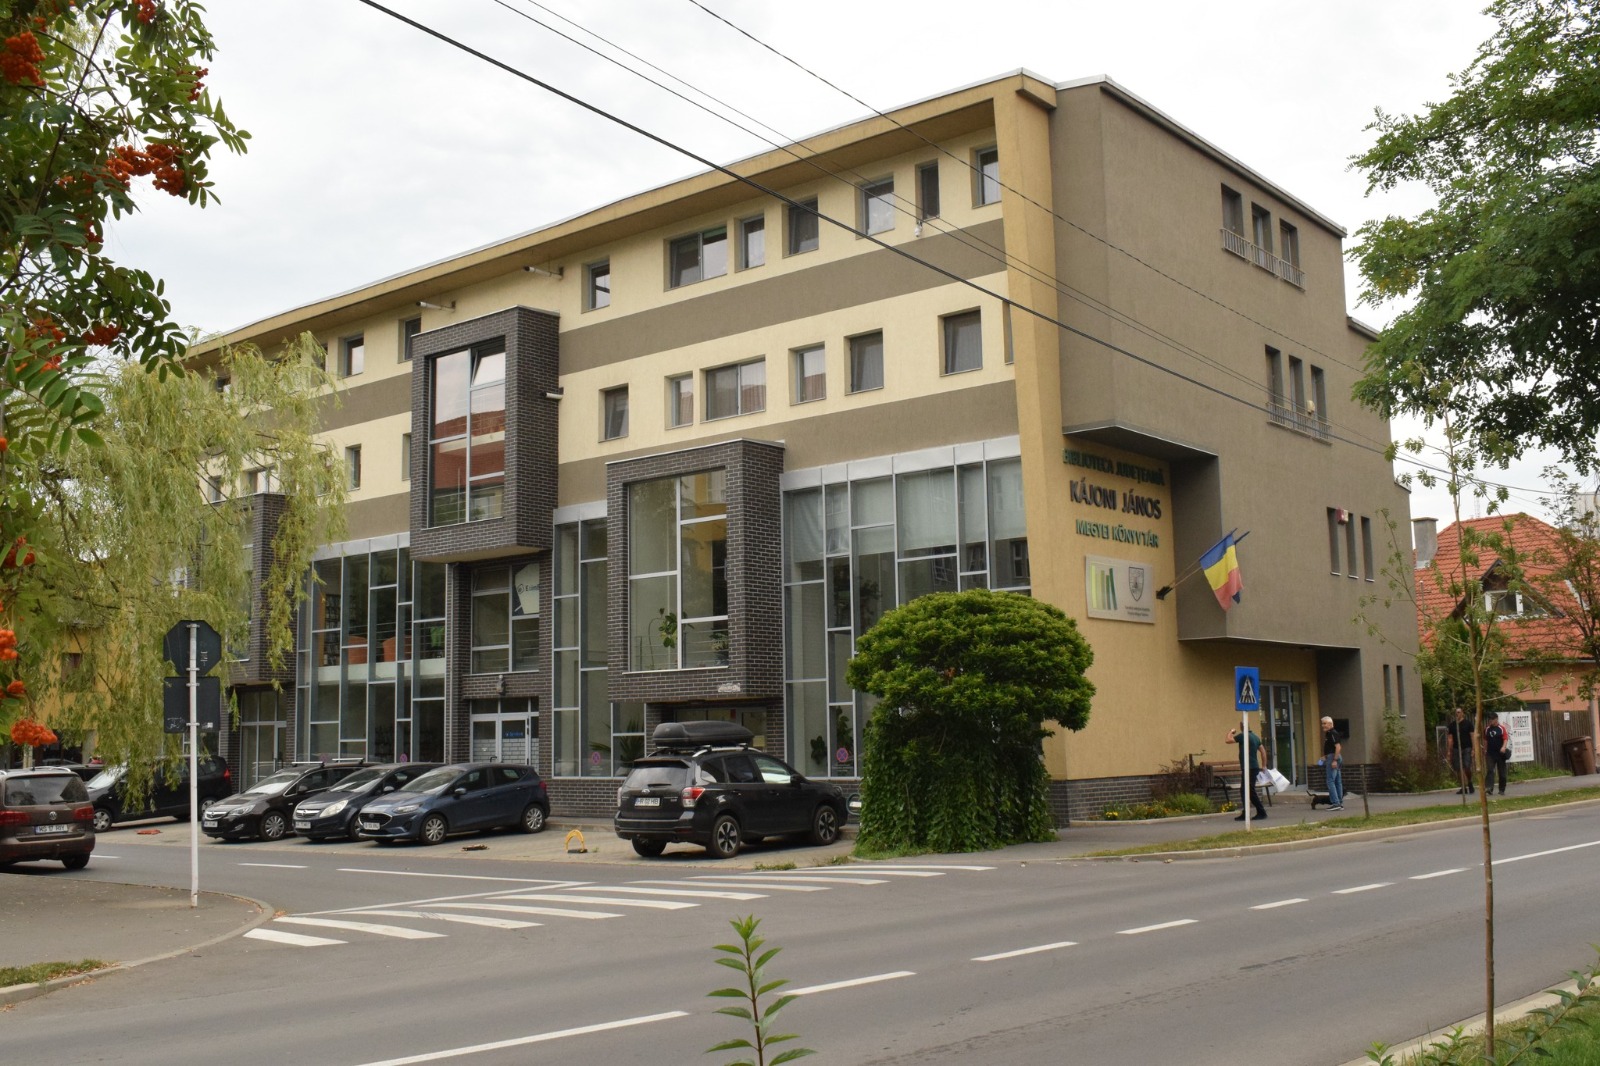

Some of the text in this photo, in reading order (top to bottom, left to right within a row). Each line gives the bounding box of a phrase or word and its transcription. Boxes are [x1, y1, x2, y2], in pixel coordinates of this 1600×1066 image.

[1063, 449, 1114, 474] BIBLIOTECA
[1070, 477, 1162, 520] KÁJONI JÁNOS
[1076, 519, 1159, 548] MEGYEI KÖNYVTÁR
